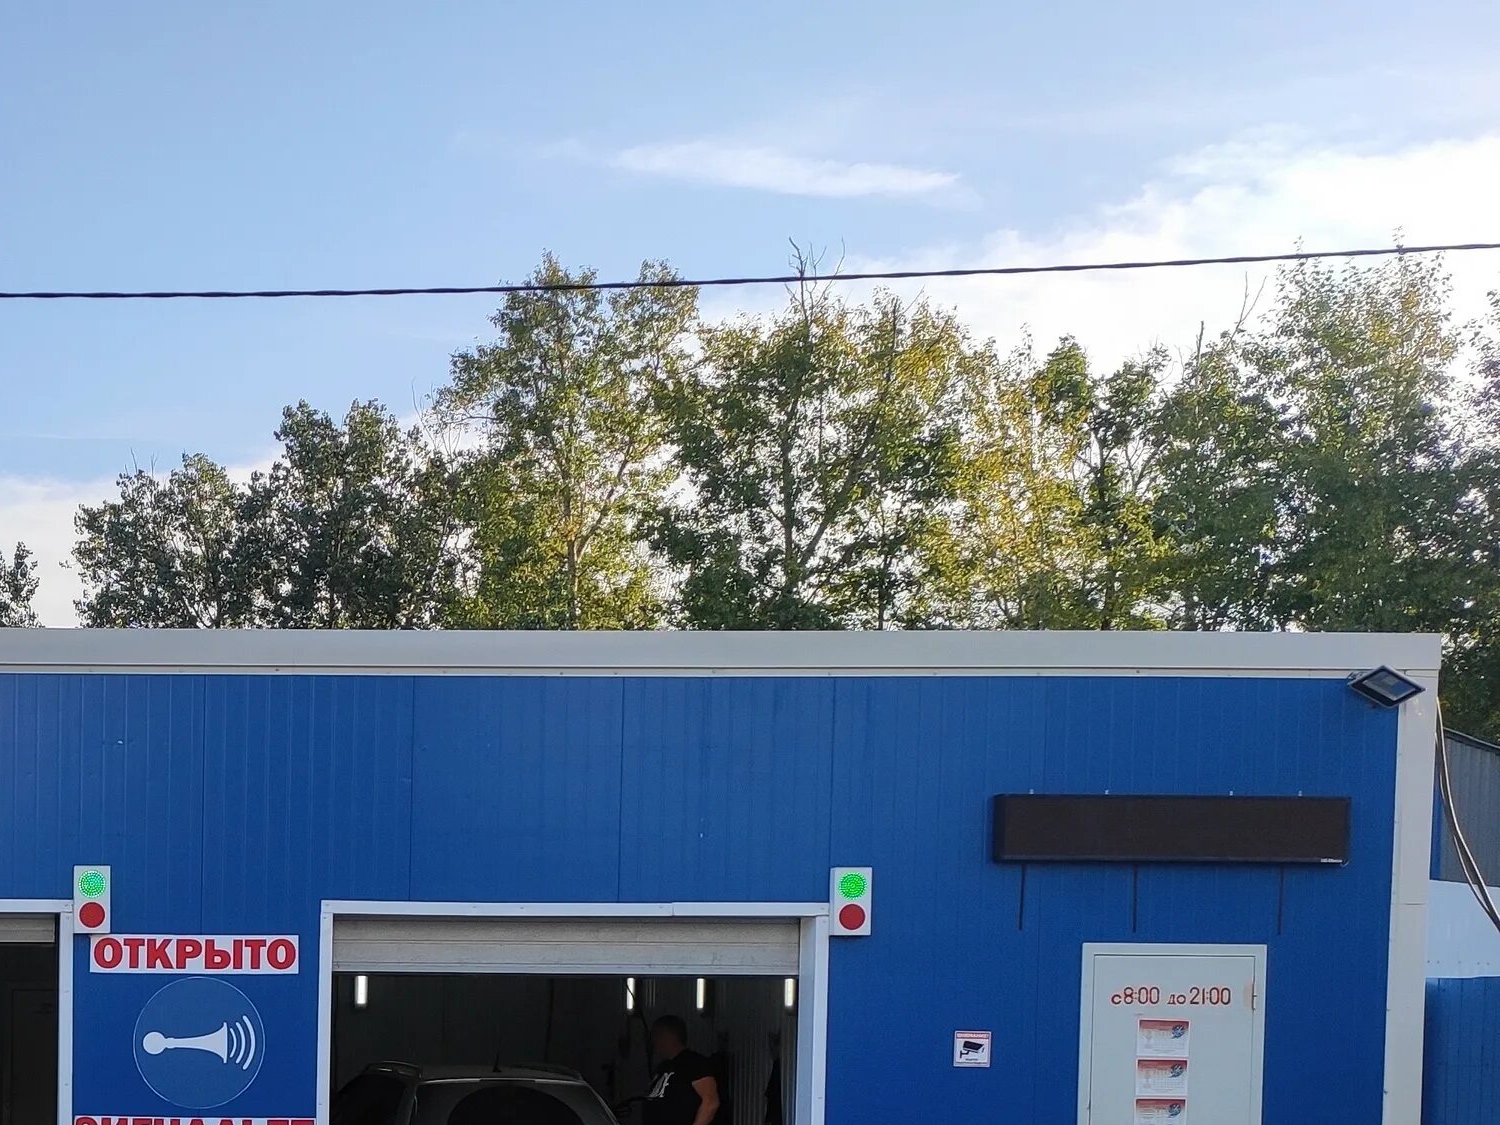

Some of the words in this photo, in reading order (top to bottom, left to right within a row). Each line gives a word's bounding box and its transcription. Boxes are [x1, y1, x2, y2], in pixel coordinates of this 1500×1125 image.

[93, 936, 297, 971] ОТКРЫТО
[1167, 994, 1187, 1005] до
[1189, 987, 1232, 1005] 21:00
